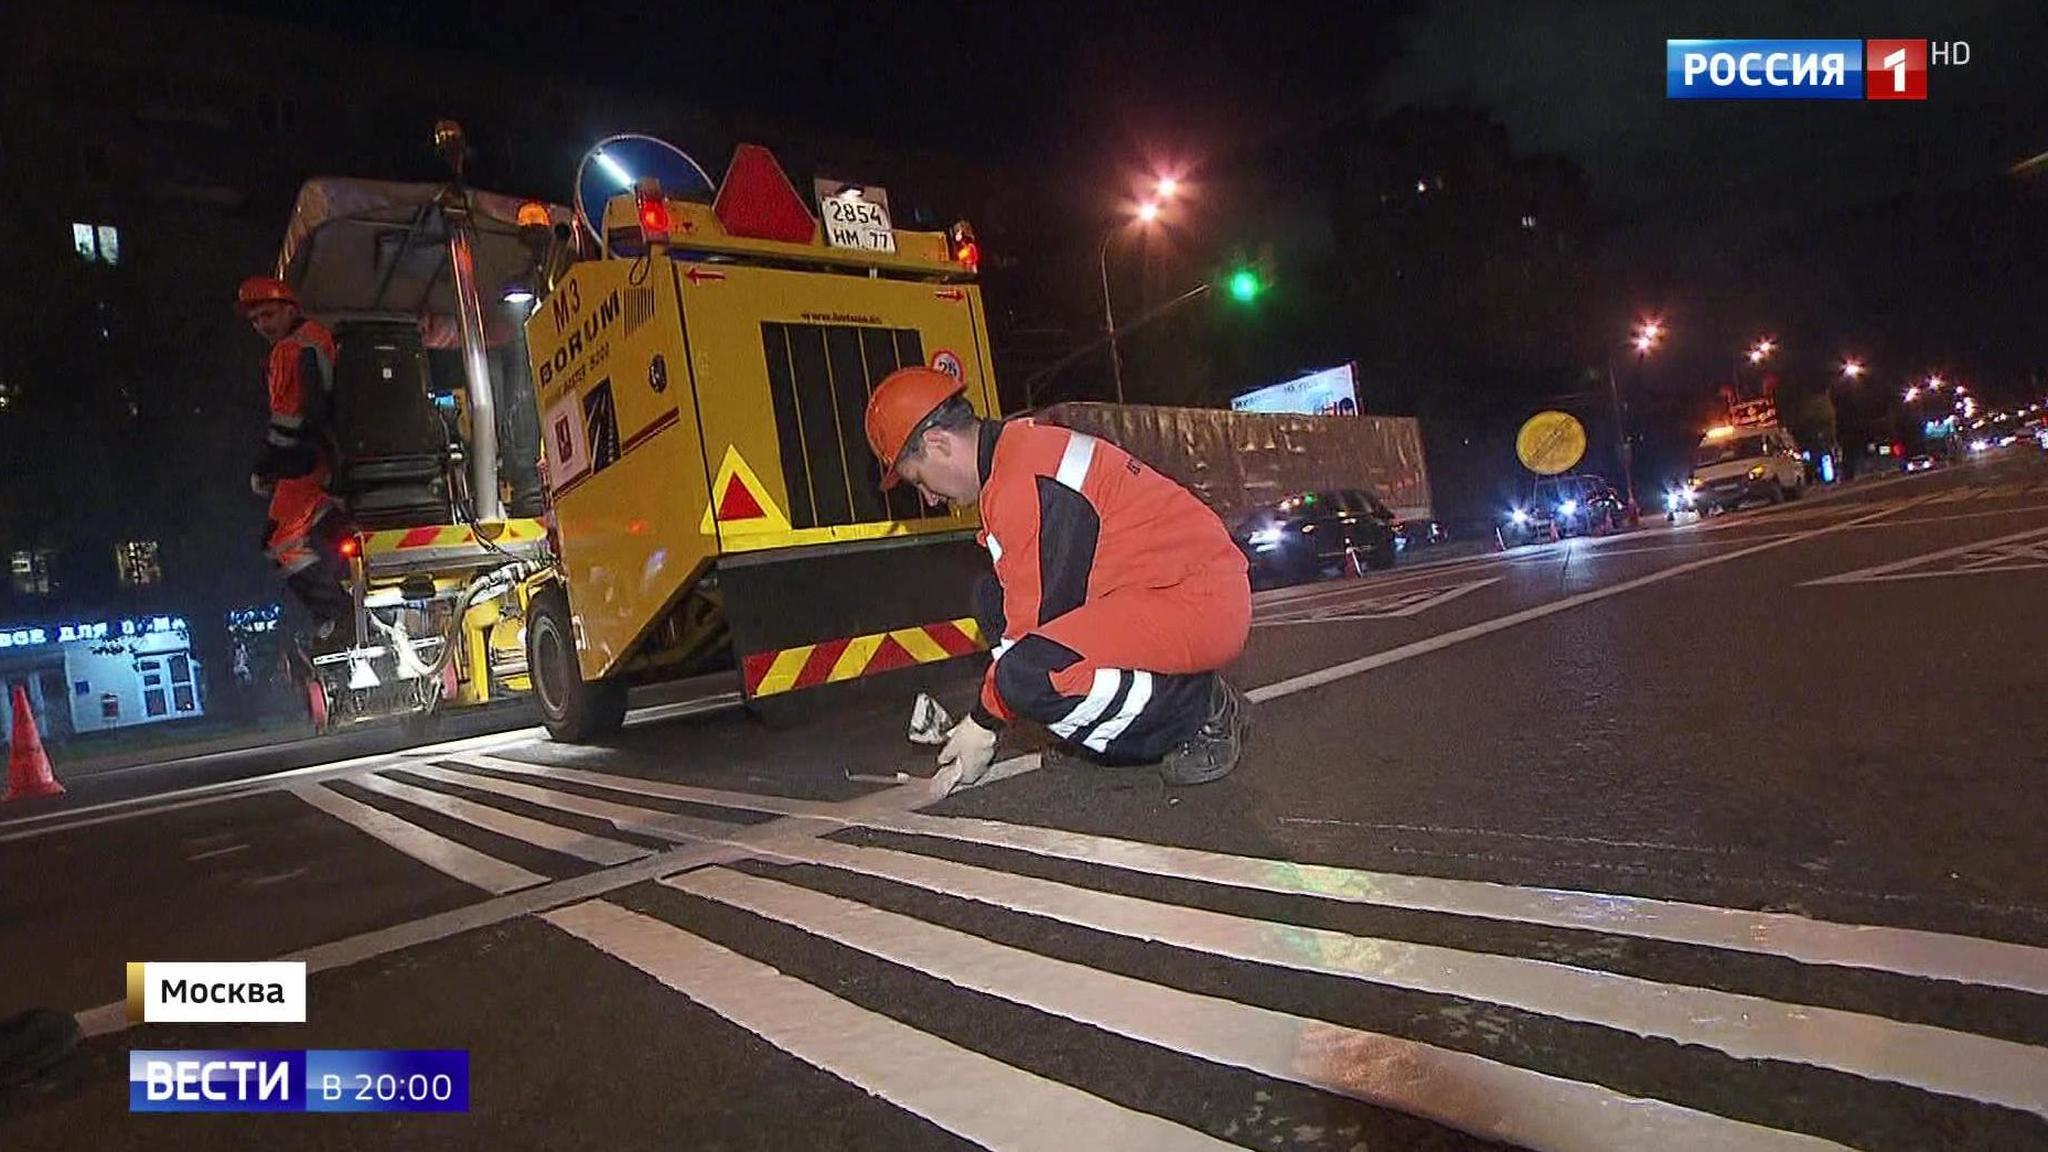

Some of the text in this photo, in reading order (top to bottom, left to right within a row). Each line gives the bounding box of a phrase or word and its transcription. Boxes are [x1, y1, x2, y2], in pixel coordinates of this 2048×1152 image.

[829, 200, 882, 226] 2854
[869, 231, 888, 248] 77
[539, 288, 620, 388] BORUM
[58, 622, 108, 642] ДЛЯ
